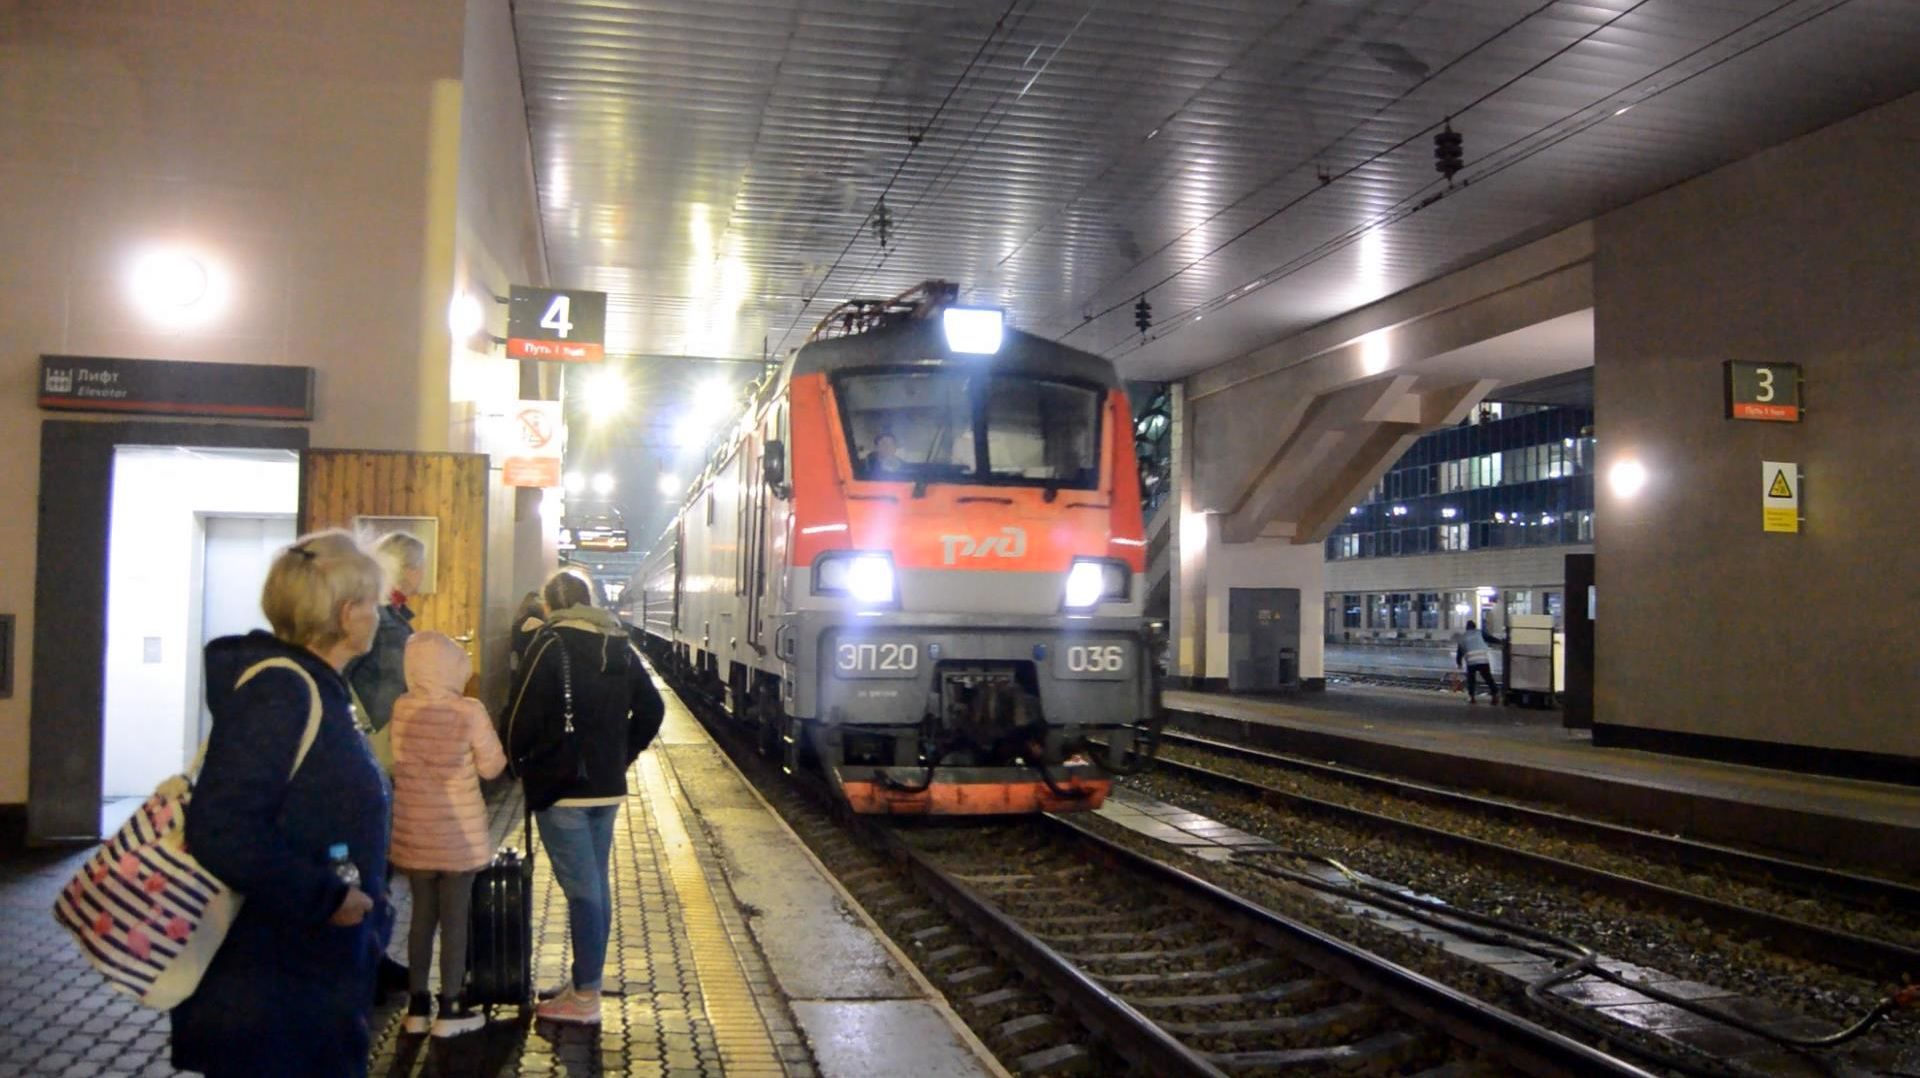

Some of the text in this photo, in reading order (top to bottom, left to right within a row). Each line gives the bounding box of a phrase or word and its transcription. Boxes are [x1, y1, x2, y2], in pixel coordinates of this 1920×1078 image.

[540, 295, 573, 340] 4
[78, 368, 119, 384] Лифт
[1756, 368, 1774, 402] 3
[838, 643, 918, 672] ЭП20
[1066, 646, 1124, 672] 036
